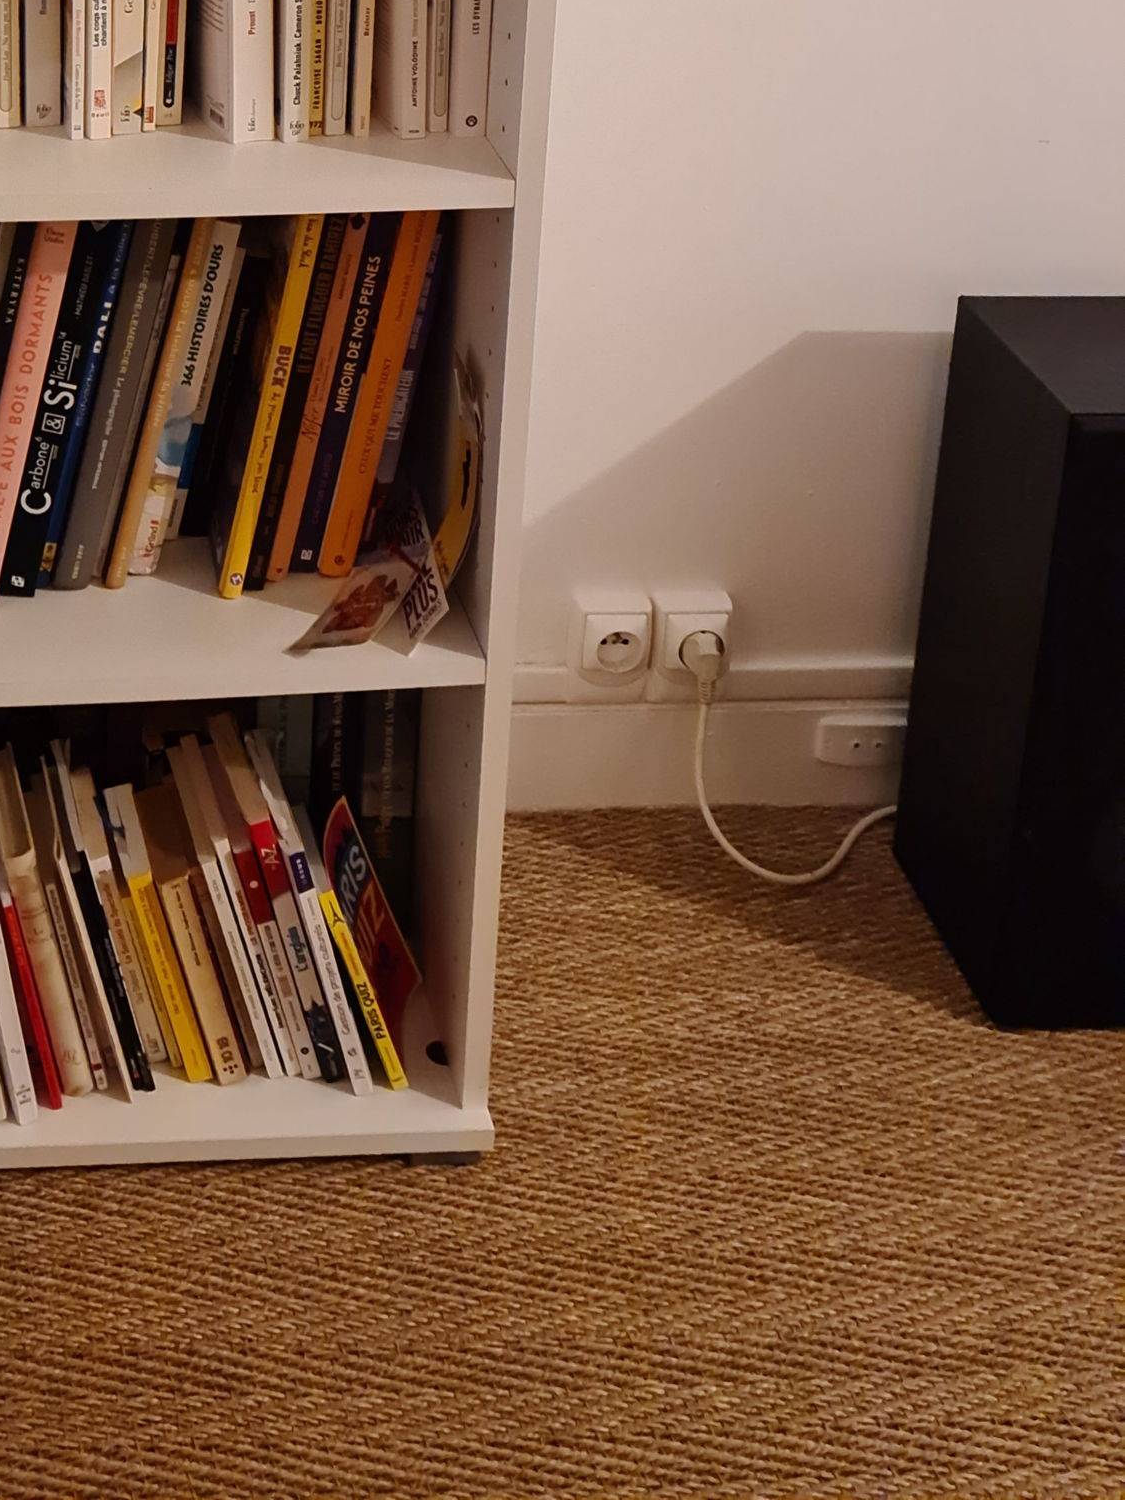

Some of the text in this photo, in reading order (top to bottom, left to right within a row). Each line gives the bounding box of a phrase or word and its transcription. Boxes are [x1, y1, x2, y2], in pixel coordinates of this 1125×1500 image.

[93, 12, 102, 29] coqs
[247, 11, 255, 35] Proust
[294, 4, 303, 39] Cameron
[472, 22, 480, 35] LES
[293, 42, 302, 80] Palahniuk
[293, 82, 301, 106] Chuck
[18, 274, 53, 375] DORMANTS
[180, 244, 225, 387] 366 HISTOIRES D'OURS
[335, 255, 382, 413] MIROIR DE NOS PEINES
[270, 345, 292, 387] BUCK
[8, 385, 29, 425] BOIS
[1, 435, 20, 472] AUX
[355, 980, 385, 1040] PARIS QUIZ
